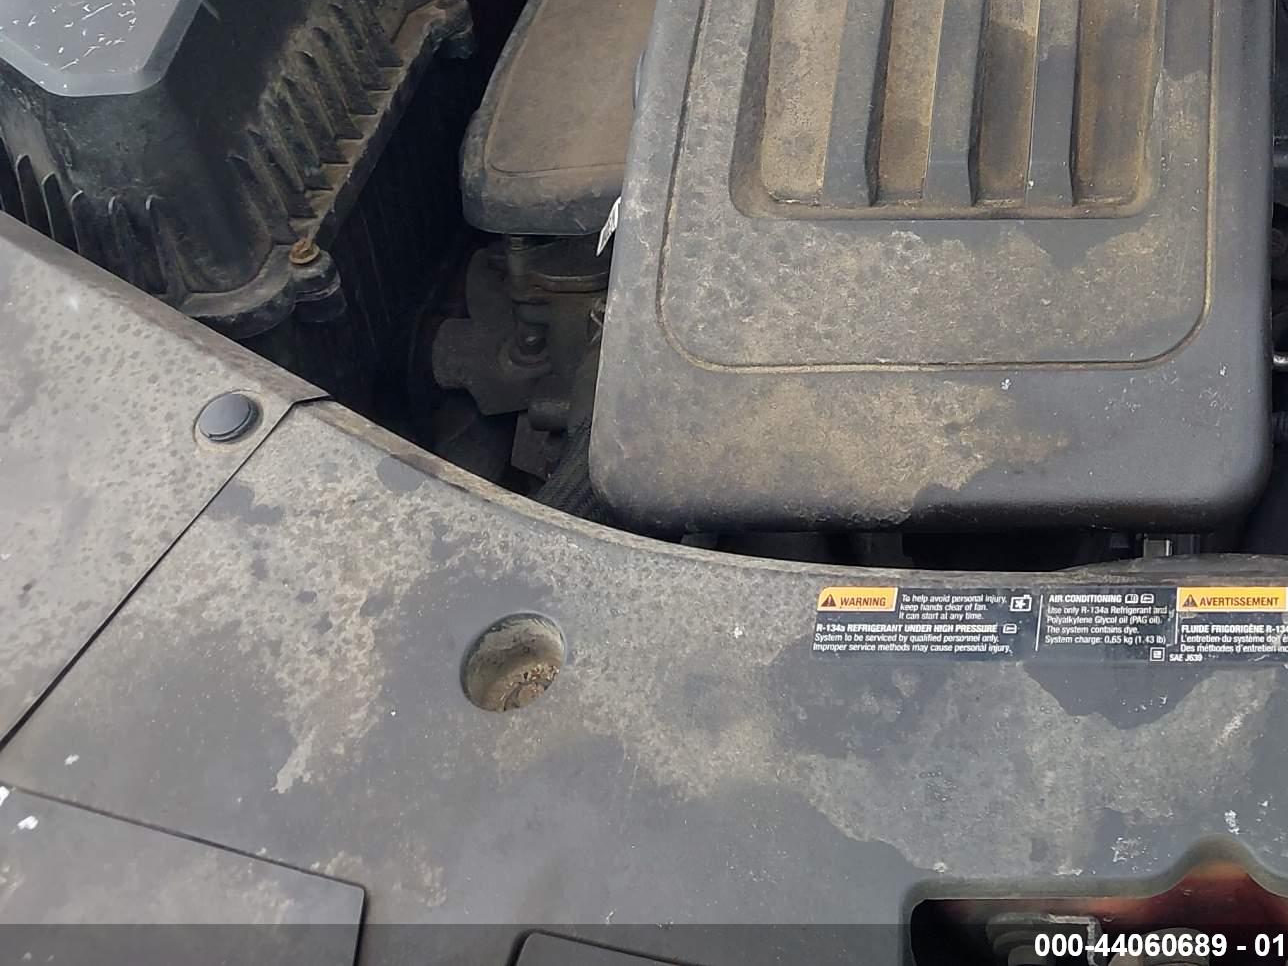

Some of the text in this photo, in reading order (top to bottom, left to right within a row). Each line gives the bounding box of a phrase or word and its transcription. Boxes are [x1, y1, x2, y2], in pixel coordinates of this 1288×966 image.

[840, 597, 886, 606] WARNING
[902, 594, 910, 602] To
[912, 594, 928, 604] help
[930, 594, 950, 602] avoid
[951, 594, 983, 604] personal
[1048, 594, 1122, 603] AIR CONDITIONING
[1200, 597, 1280, 606] AVERTISSEMENT
[900, 604, 918, 612] keep
[1048, 606, 1168, 616] Use only R-134a Refrigerant and
[898, 612, 904, 620] It
[949, 614, 963, 622] any
[1046, 616, 1093, 624] Polyalkylene
[1094, 616, 1117, 624] Glycol
[1119, 616, 1128, 624] oil
[1130, 616, 1148, 624] (PAG
[816, 624, 998, 633] R-134a REFRIGERANT UNDER HIGH PRESSURE
[1046, 626, 1140, 635] The system contains dye.
[1181, 624, 1210, 633] FLUIDE
[1211, 624, 1264, 633] FRIGORIGÈNE
[814, 634, 1000, 643] System to be serviced by qualified personnel only.
[1045, 635, 1166, 644] System charge: 0.65 kg (1.43 lb)
[1180, 634, 1220, 642] L'entretien
[1222, 634, 1232, 642] du
[1234, 634, 1265, 644] système
[813, 643, 846, 652] Improper
[848, 644, 876, 652] service
[877, 644, 910, 652] methods
[912, 645, 928, 653] may
[954, 644, 986, 652] personal
[1180, 644, 1195, 652] Des
[1197, 644, 1234, 652] méthodes
[1236, 644, 1278, 652] d'entretien
[1169, 654, 1203, 662] SAE J639
